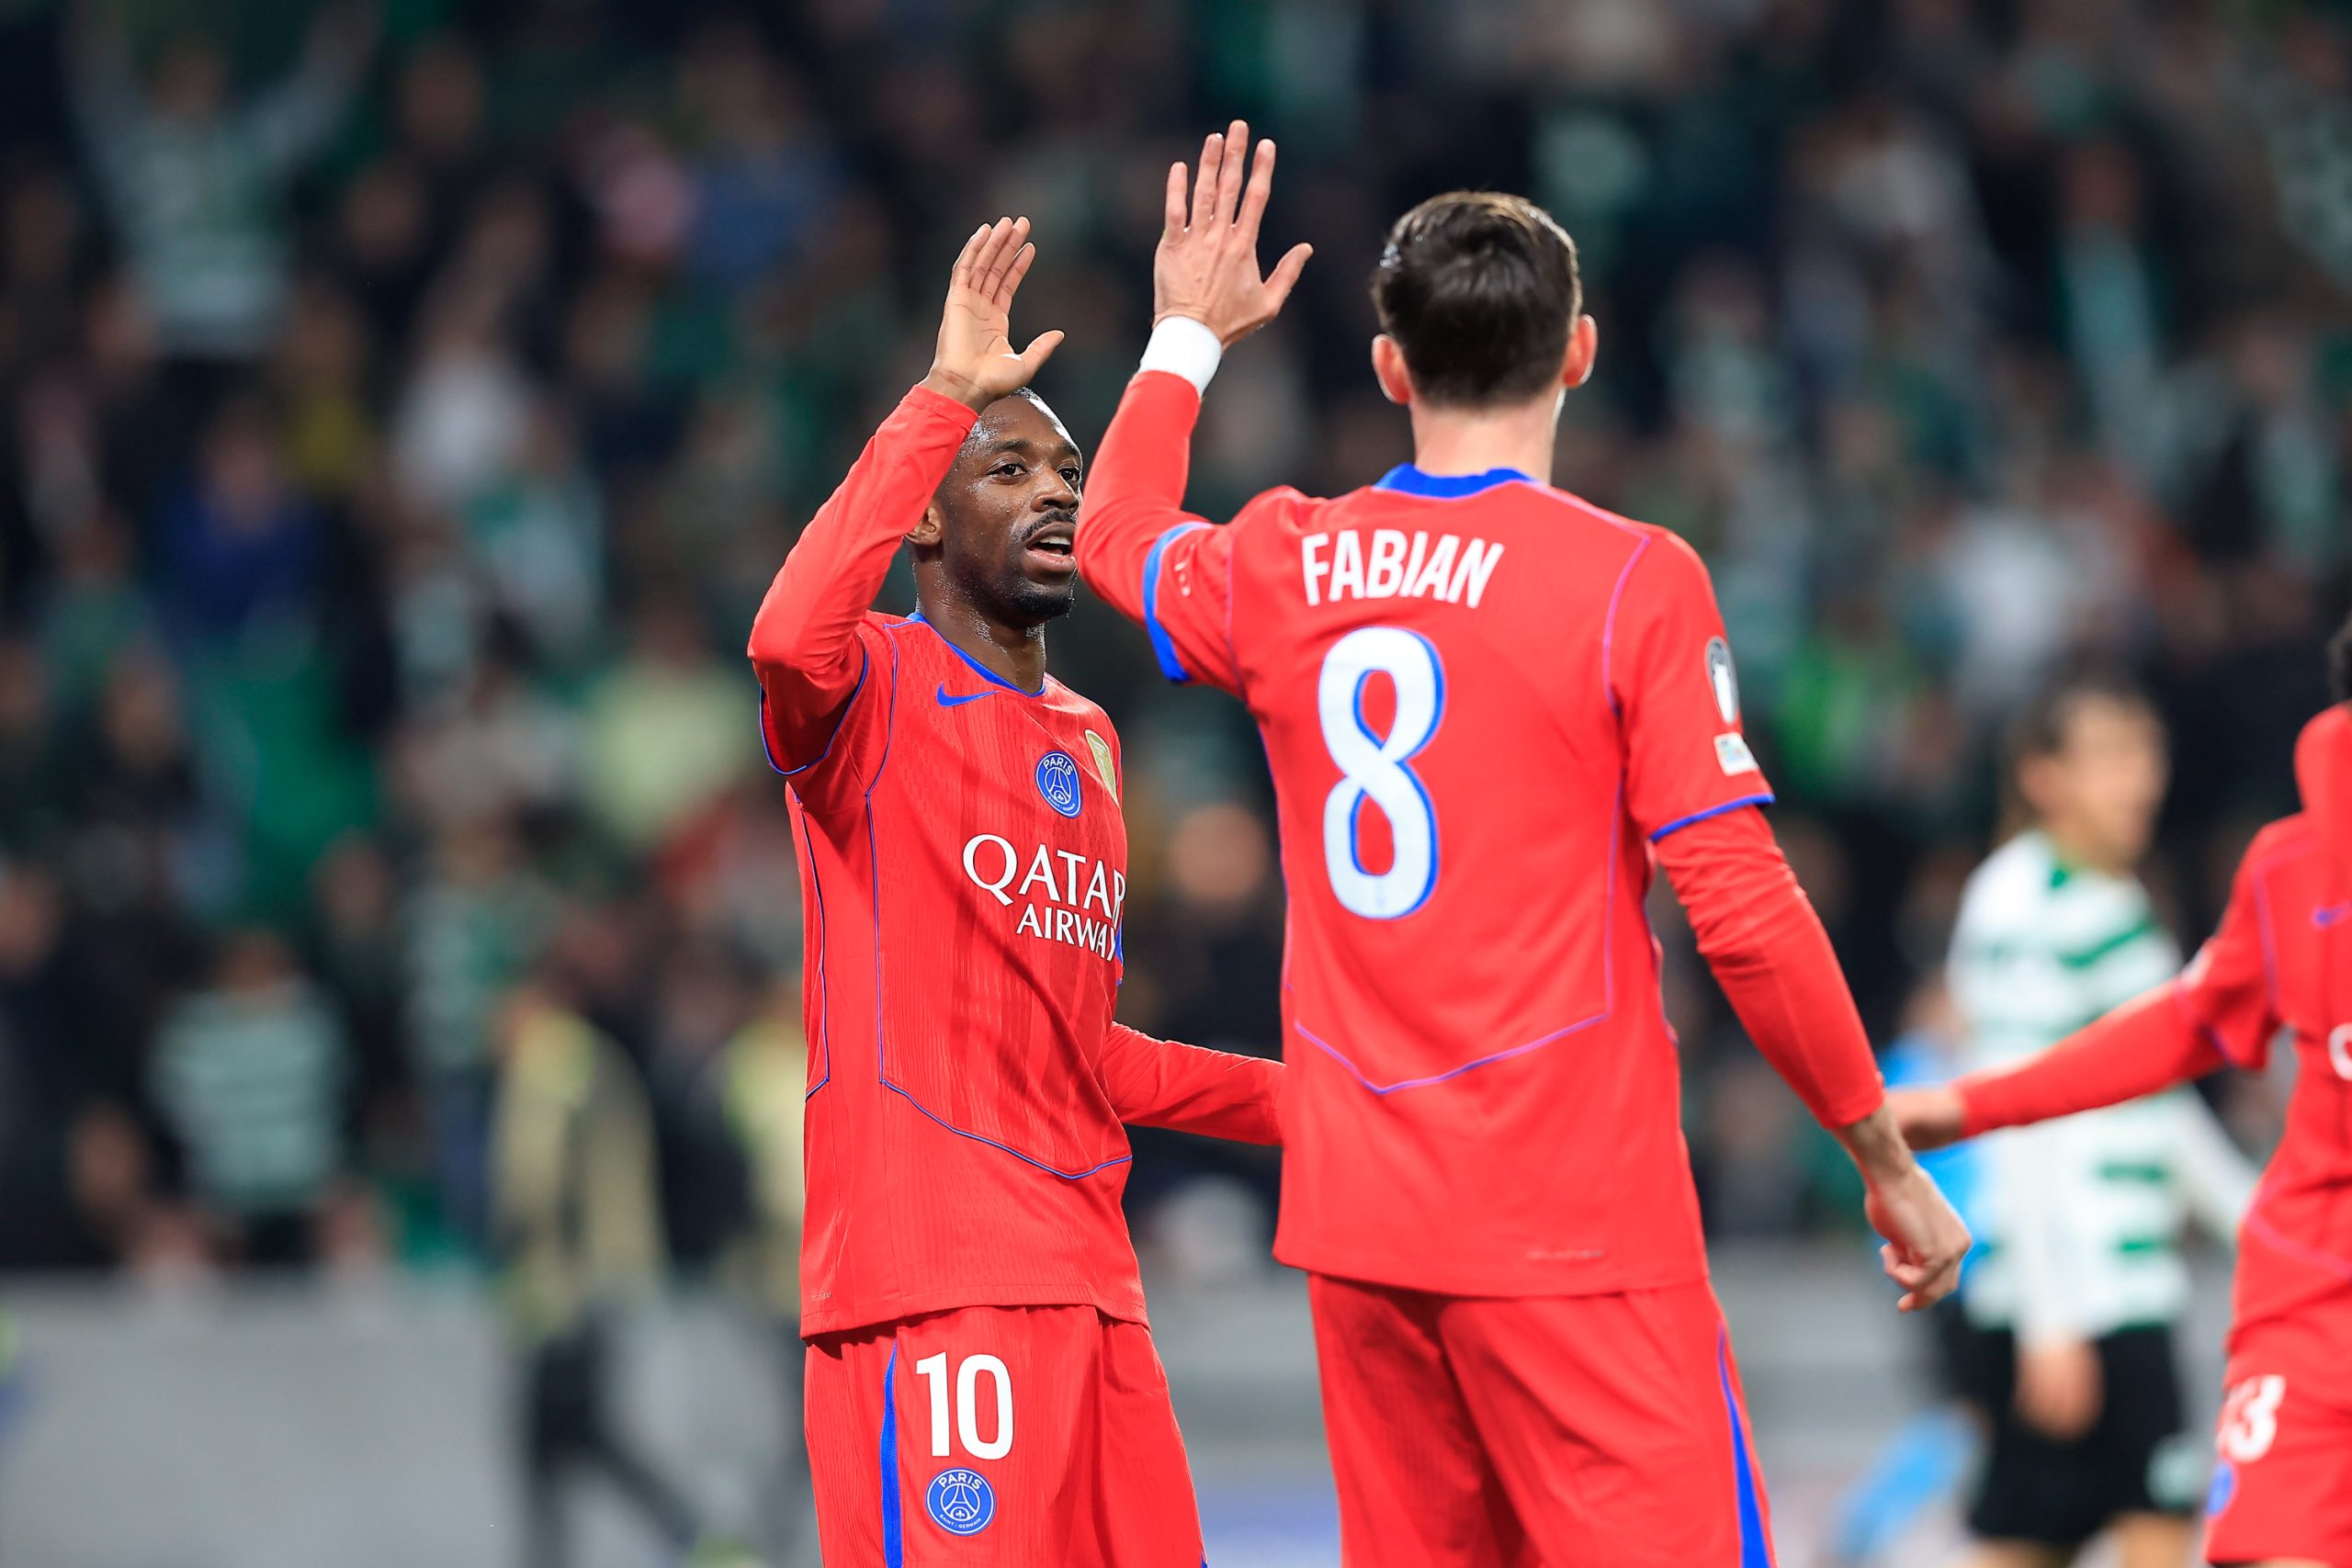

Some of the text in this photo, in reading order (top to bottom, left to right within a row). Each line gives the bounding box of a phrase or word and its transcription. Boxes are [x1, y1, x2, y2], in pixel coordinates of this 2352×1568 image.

[1301, 528, 1505, 609] FABIAN
[1043, 756, 1073, 776] PARIS
[1317, 625, 1446, 920] 8
[962, 833, 1127, 931] QATAR
[1015, 902, 1117, 962] AIRWAY
[915, 1350, 1015, 1461] 10
[937, 1472, 983, 1490] PARIS
